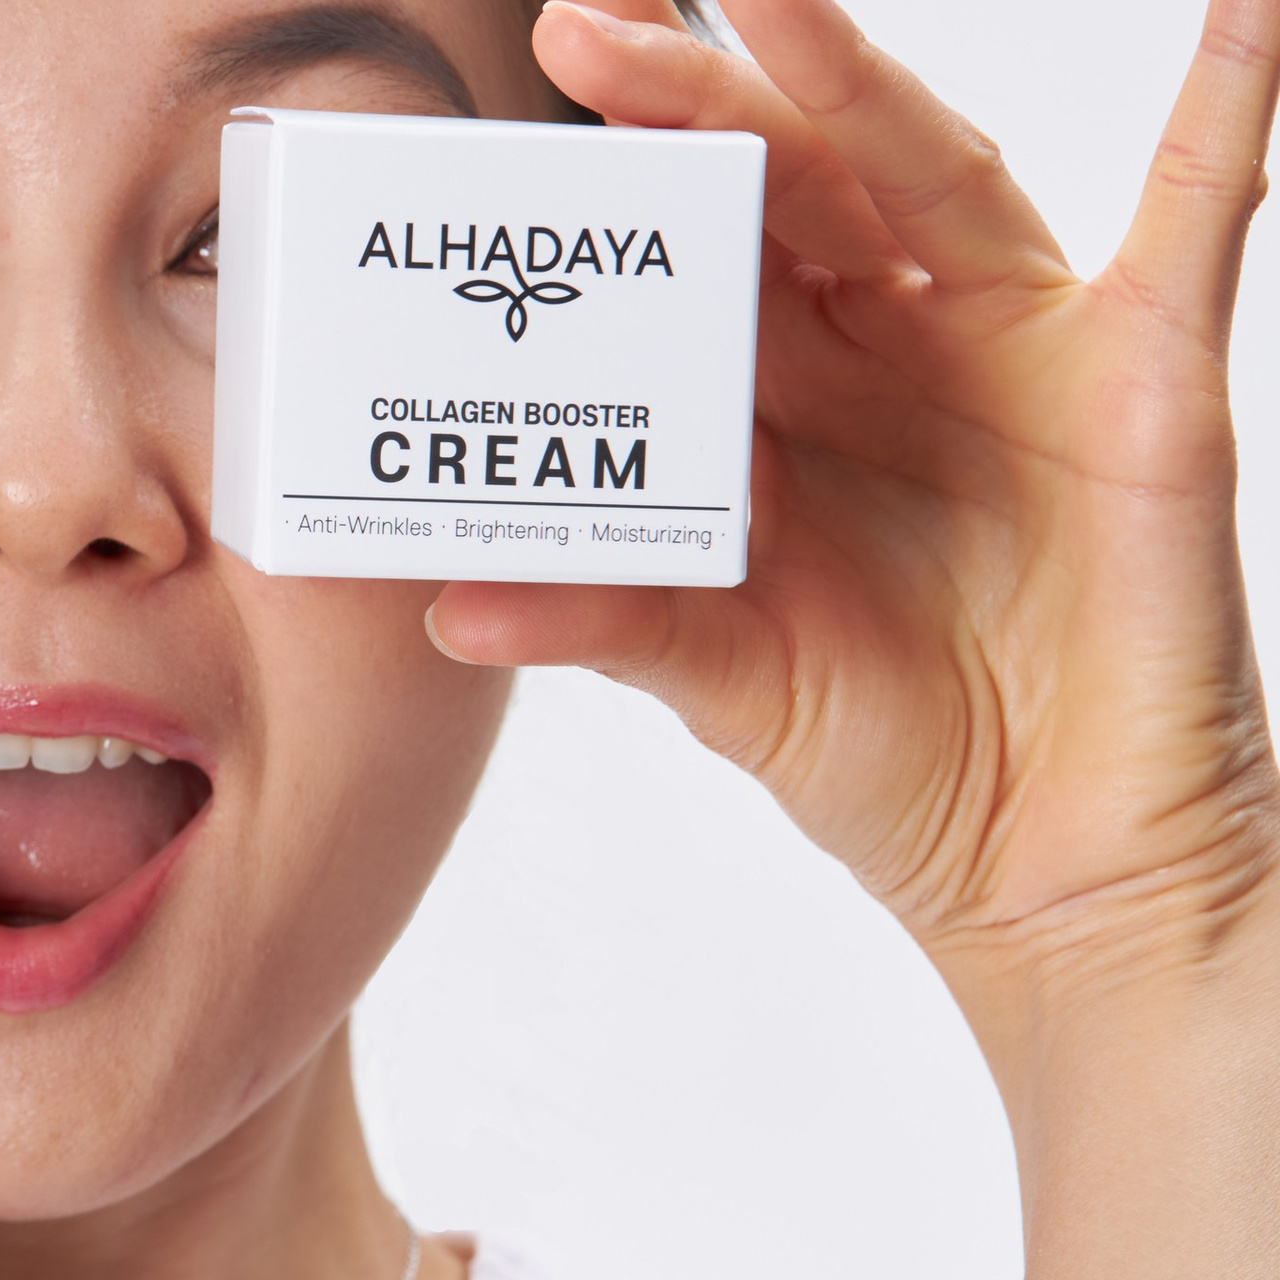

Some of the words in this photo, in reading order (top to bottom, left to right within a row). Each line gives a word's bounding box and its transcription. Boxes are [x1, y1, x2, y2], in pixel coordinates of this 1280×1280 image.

[358, 222, 674, 277] ALHADAYA
[371, 398, 514, 424] COLLAGEN
[525, 402, 649, 428] BOOSTER
[370, 431, 646, 489] CREAM
[298, 515, 432, 536] Anti-Wrinkles
[456, 519, 568, 545] Brightening
[593, 523, 711, 550] Moisturizing
